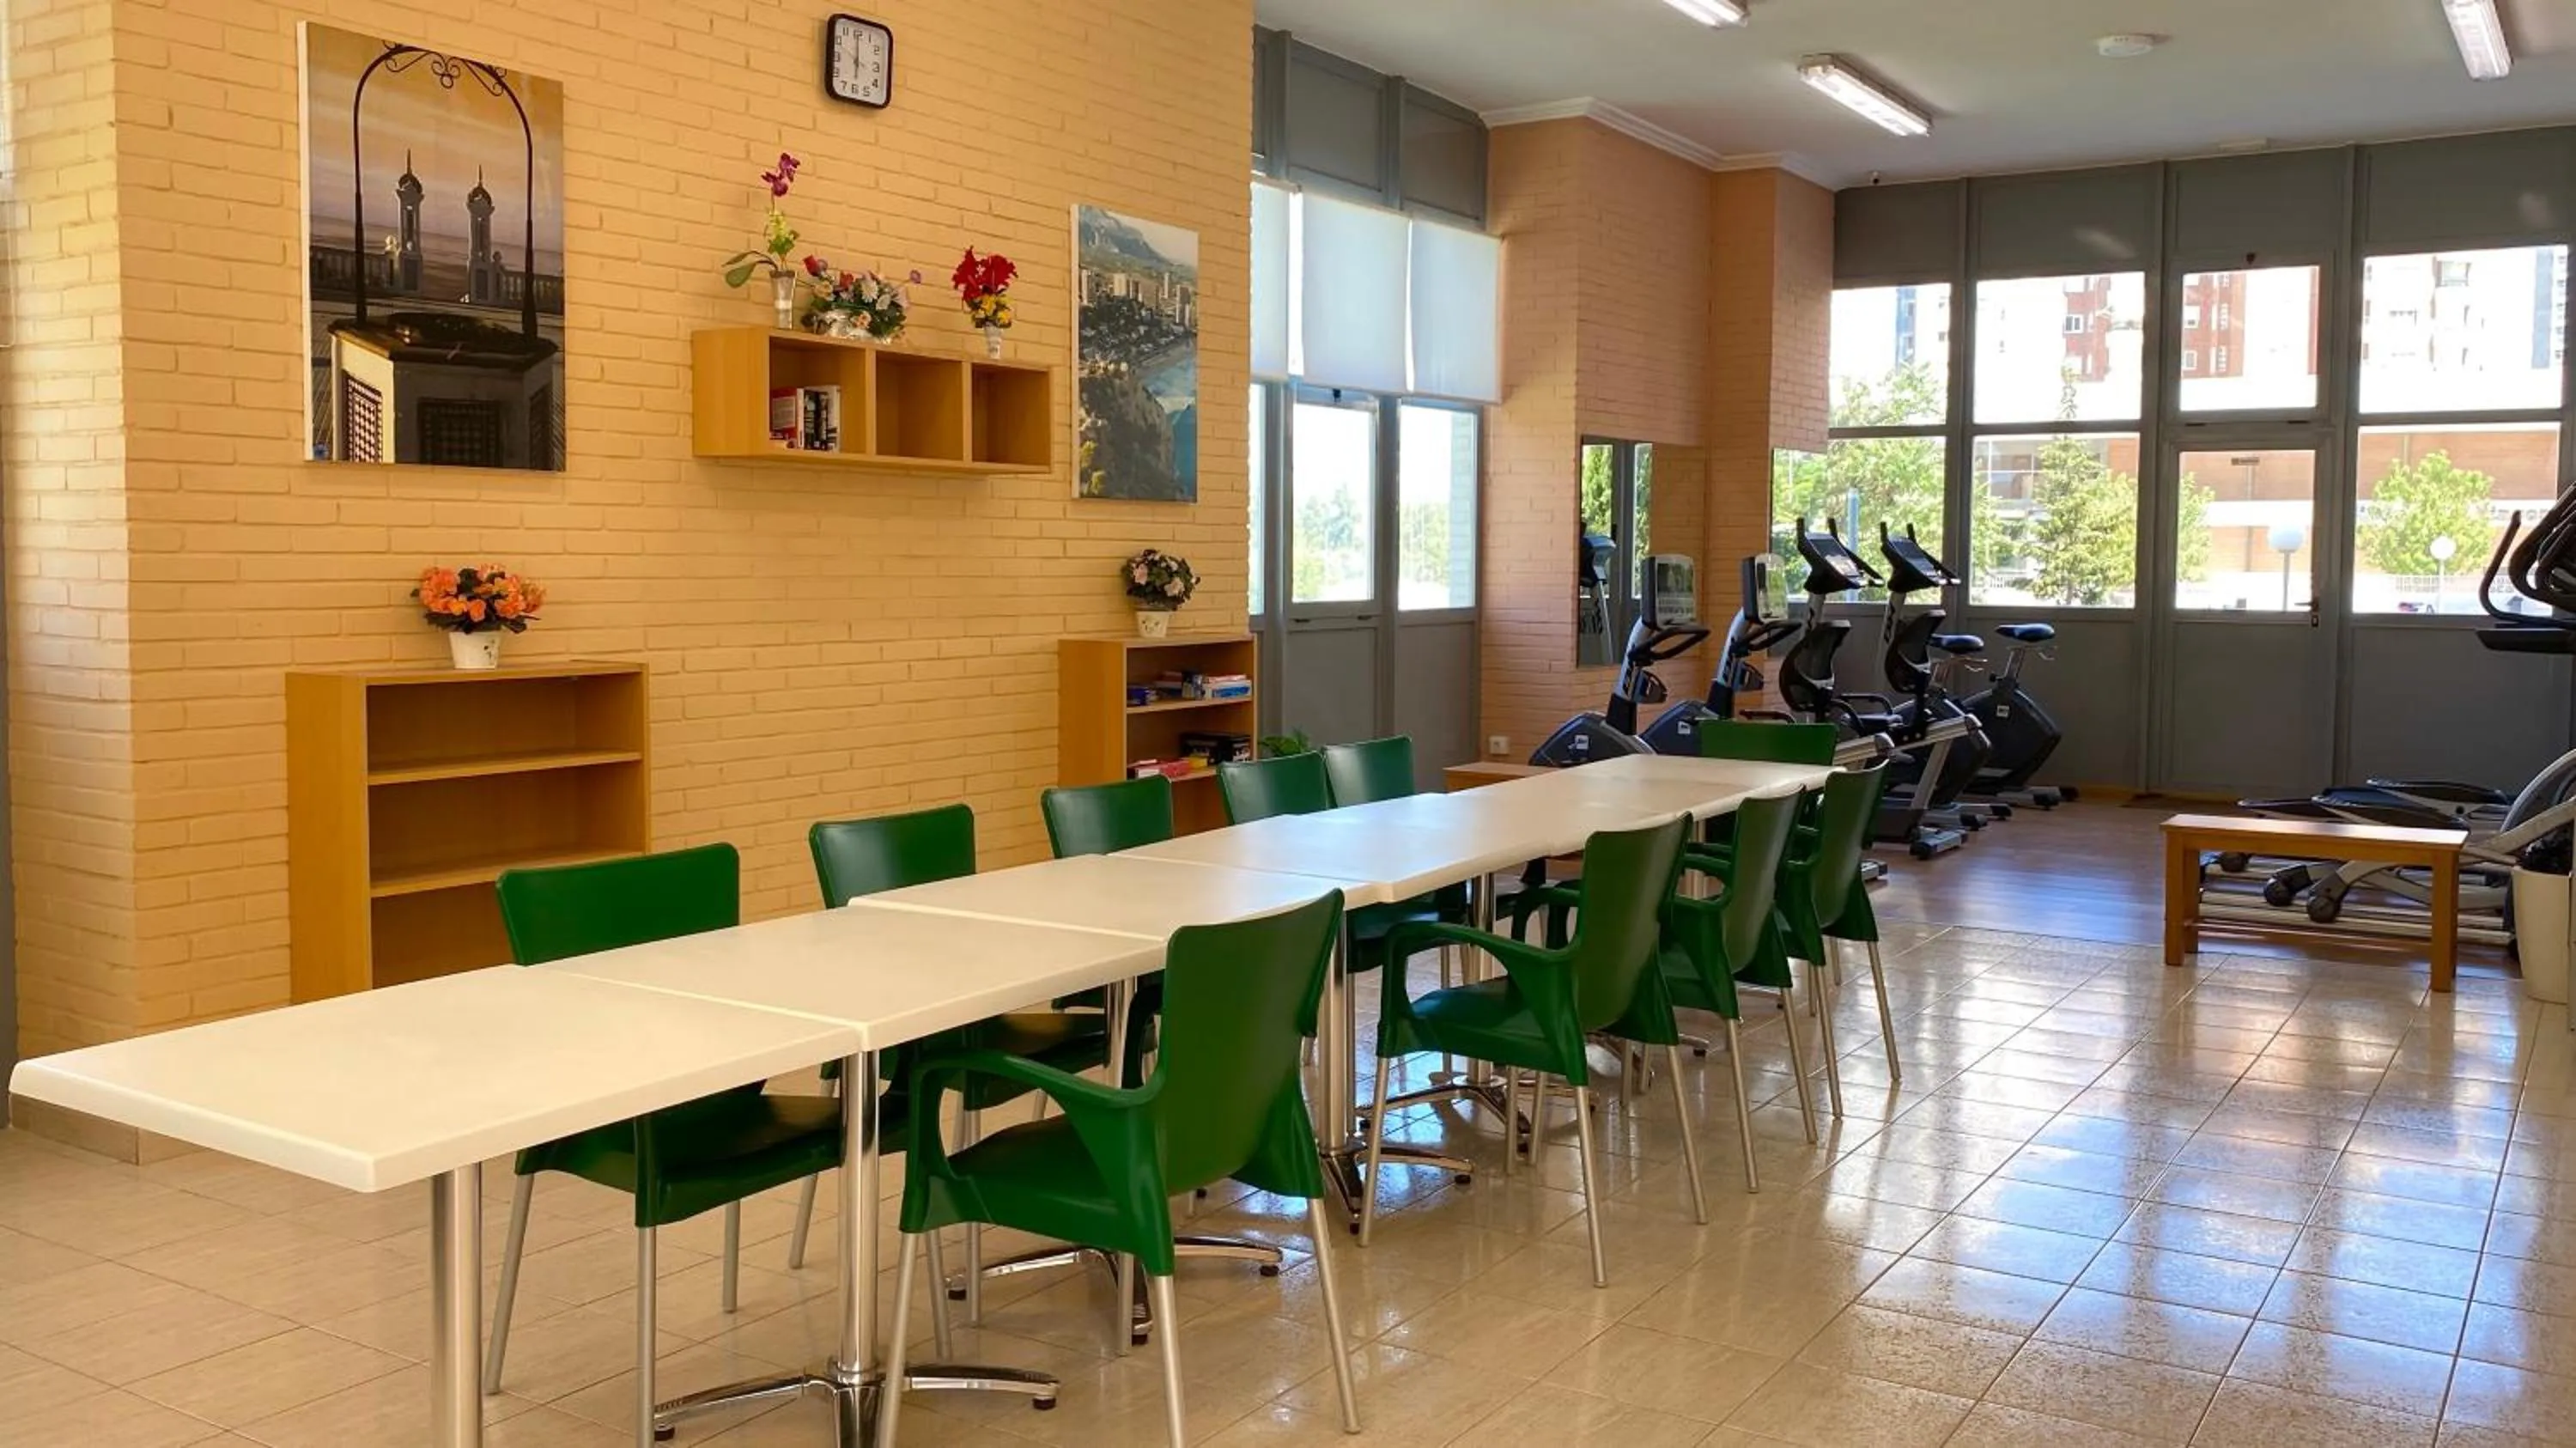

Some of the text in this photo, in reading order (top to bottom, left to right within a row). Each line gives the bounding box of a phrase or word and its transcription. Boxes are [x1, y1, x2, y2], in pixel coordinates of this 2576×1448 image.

[873, 45, 880, 55] 2
[872, 62, 879, 73] 3
[841, 80, 848, 90] 7
[872, 78, 878, 88] 4
[862, 86, 870, 97] 5
